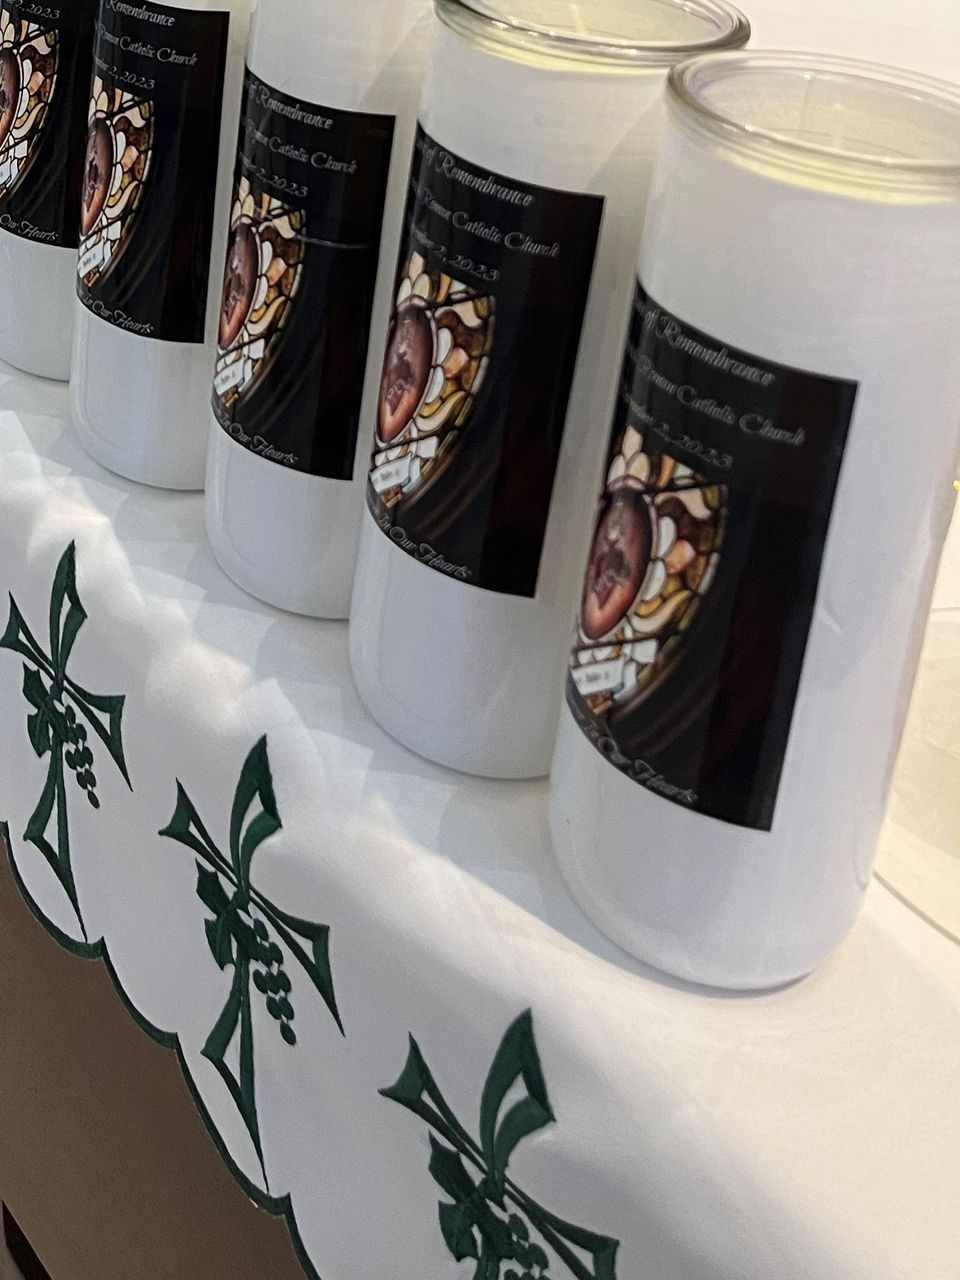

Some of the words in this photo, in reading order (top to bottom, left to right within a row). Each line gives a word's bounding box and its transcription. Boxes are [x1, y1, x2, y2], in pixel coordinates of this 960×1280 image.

[26, 3, 60, 19] 2023
[119, 35, 156, 58] Catholic
[156, 47, 198, 66] Church
[119, 71, 156, 89] 2023
[255, 85, 334, 130] Remembrance
[268, 136, 310, 163] Catholic
[310, 151, 358, 174] Church
[268, 175, 310, 198] 2023
[435, 151, 535, 208] Remembrance
[0, 213, 19, 229] Our
[18, 220, 59, 242] Hearts
[452, 211, 504, 243] Catholic
[504, 231, 559, 258] Church
[448, 255, 500, 281] 2023
[92, 300, 112, 318] Our
[111, 309, 155, 333] Hearts
[655, 314, 776, 386] Remembrance
[677, 384, 736, 425] Catholic
[739, 413, 806, 447] Church
[229, 423, 252, 442] Our
[249, 435, 299, 464] Hearts
[671, 434, 734, 468] 2023
[390, 526, 418, 551] Our
[414, 542, 473, 578] Hearts
[630, 758, 699, 804] Hearts
